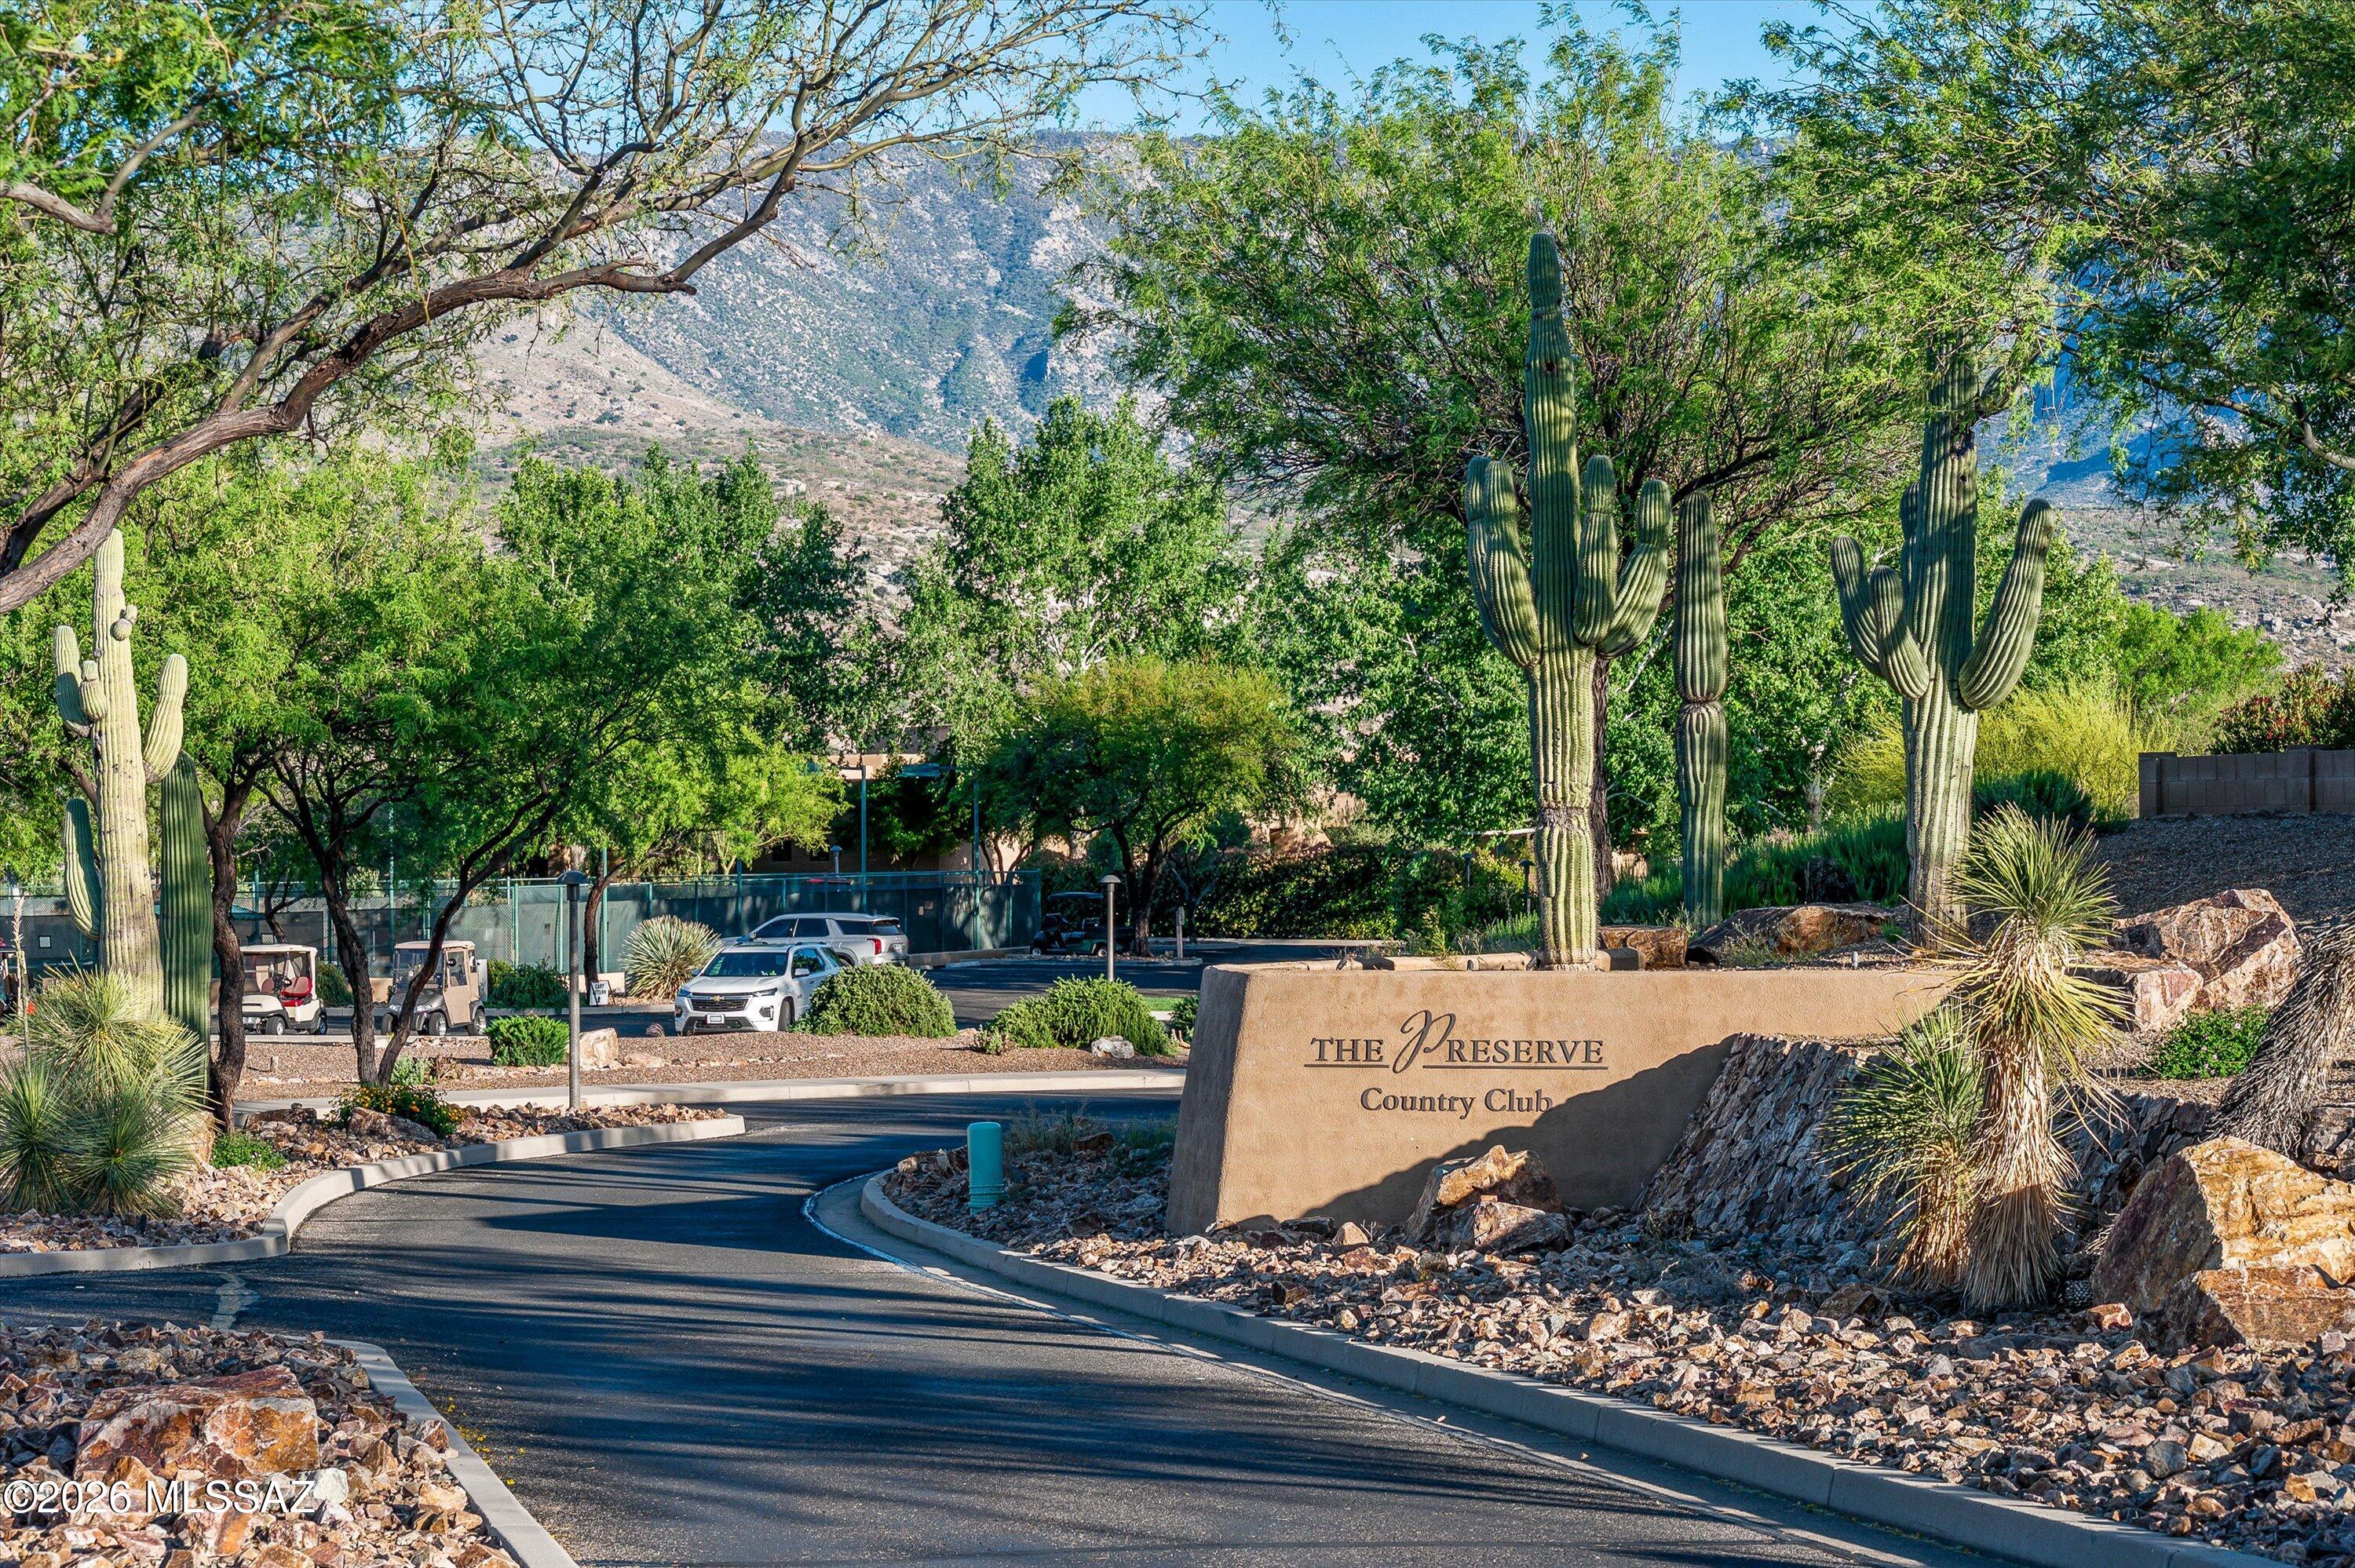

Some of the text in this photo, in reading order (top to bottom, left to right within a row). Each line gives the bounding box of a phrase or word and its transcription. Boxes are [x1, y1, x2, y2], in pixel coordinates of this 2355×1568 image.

[1310, 1010, 1604, 1074] THE PRESERVE
[1360, 1088, 1554, 1119] Country Club
